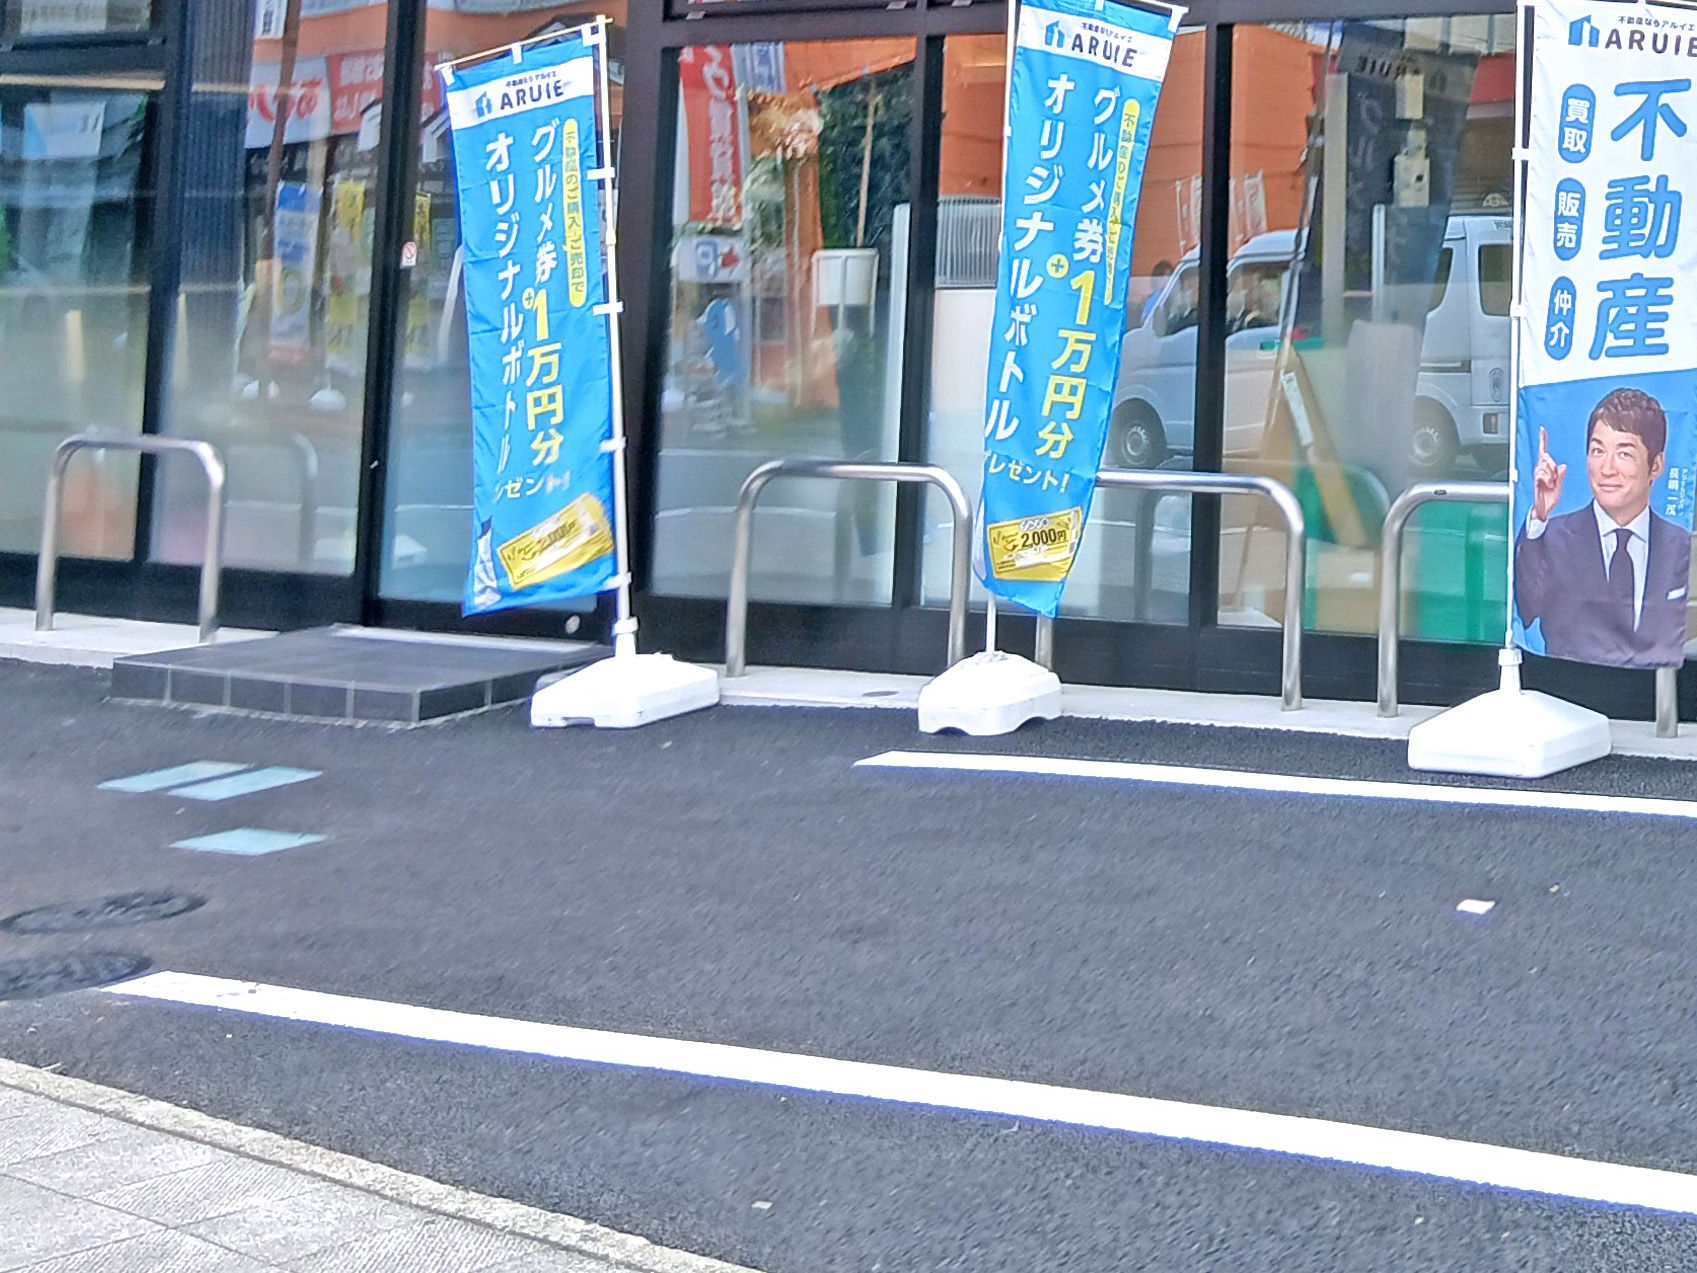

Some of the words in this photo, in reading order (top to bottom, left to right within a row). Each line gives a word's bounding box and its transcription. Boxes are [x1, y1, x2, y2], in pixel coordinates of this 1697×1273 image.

[1071, 33, 1138, 68] ARUIE
[500, 79, 564, 111] ARUIE
[1561, 97, 1591, 155] 買取
[1556, 190, 1582, 249] 販売
[1588, 78, 1692, 361] 不動産
[984, 73, 1076, 441] オリジナルボトル
[1549, 288, 1573, 349] 仲介
